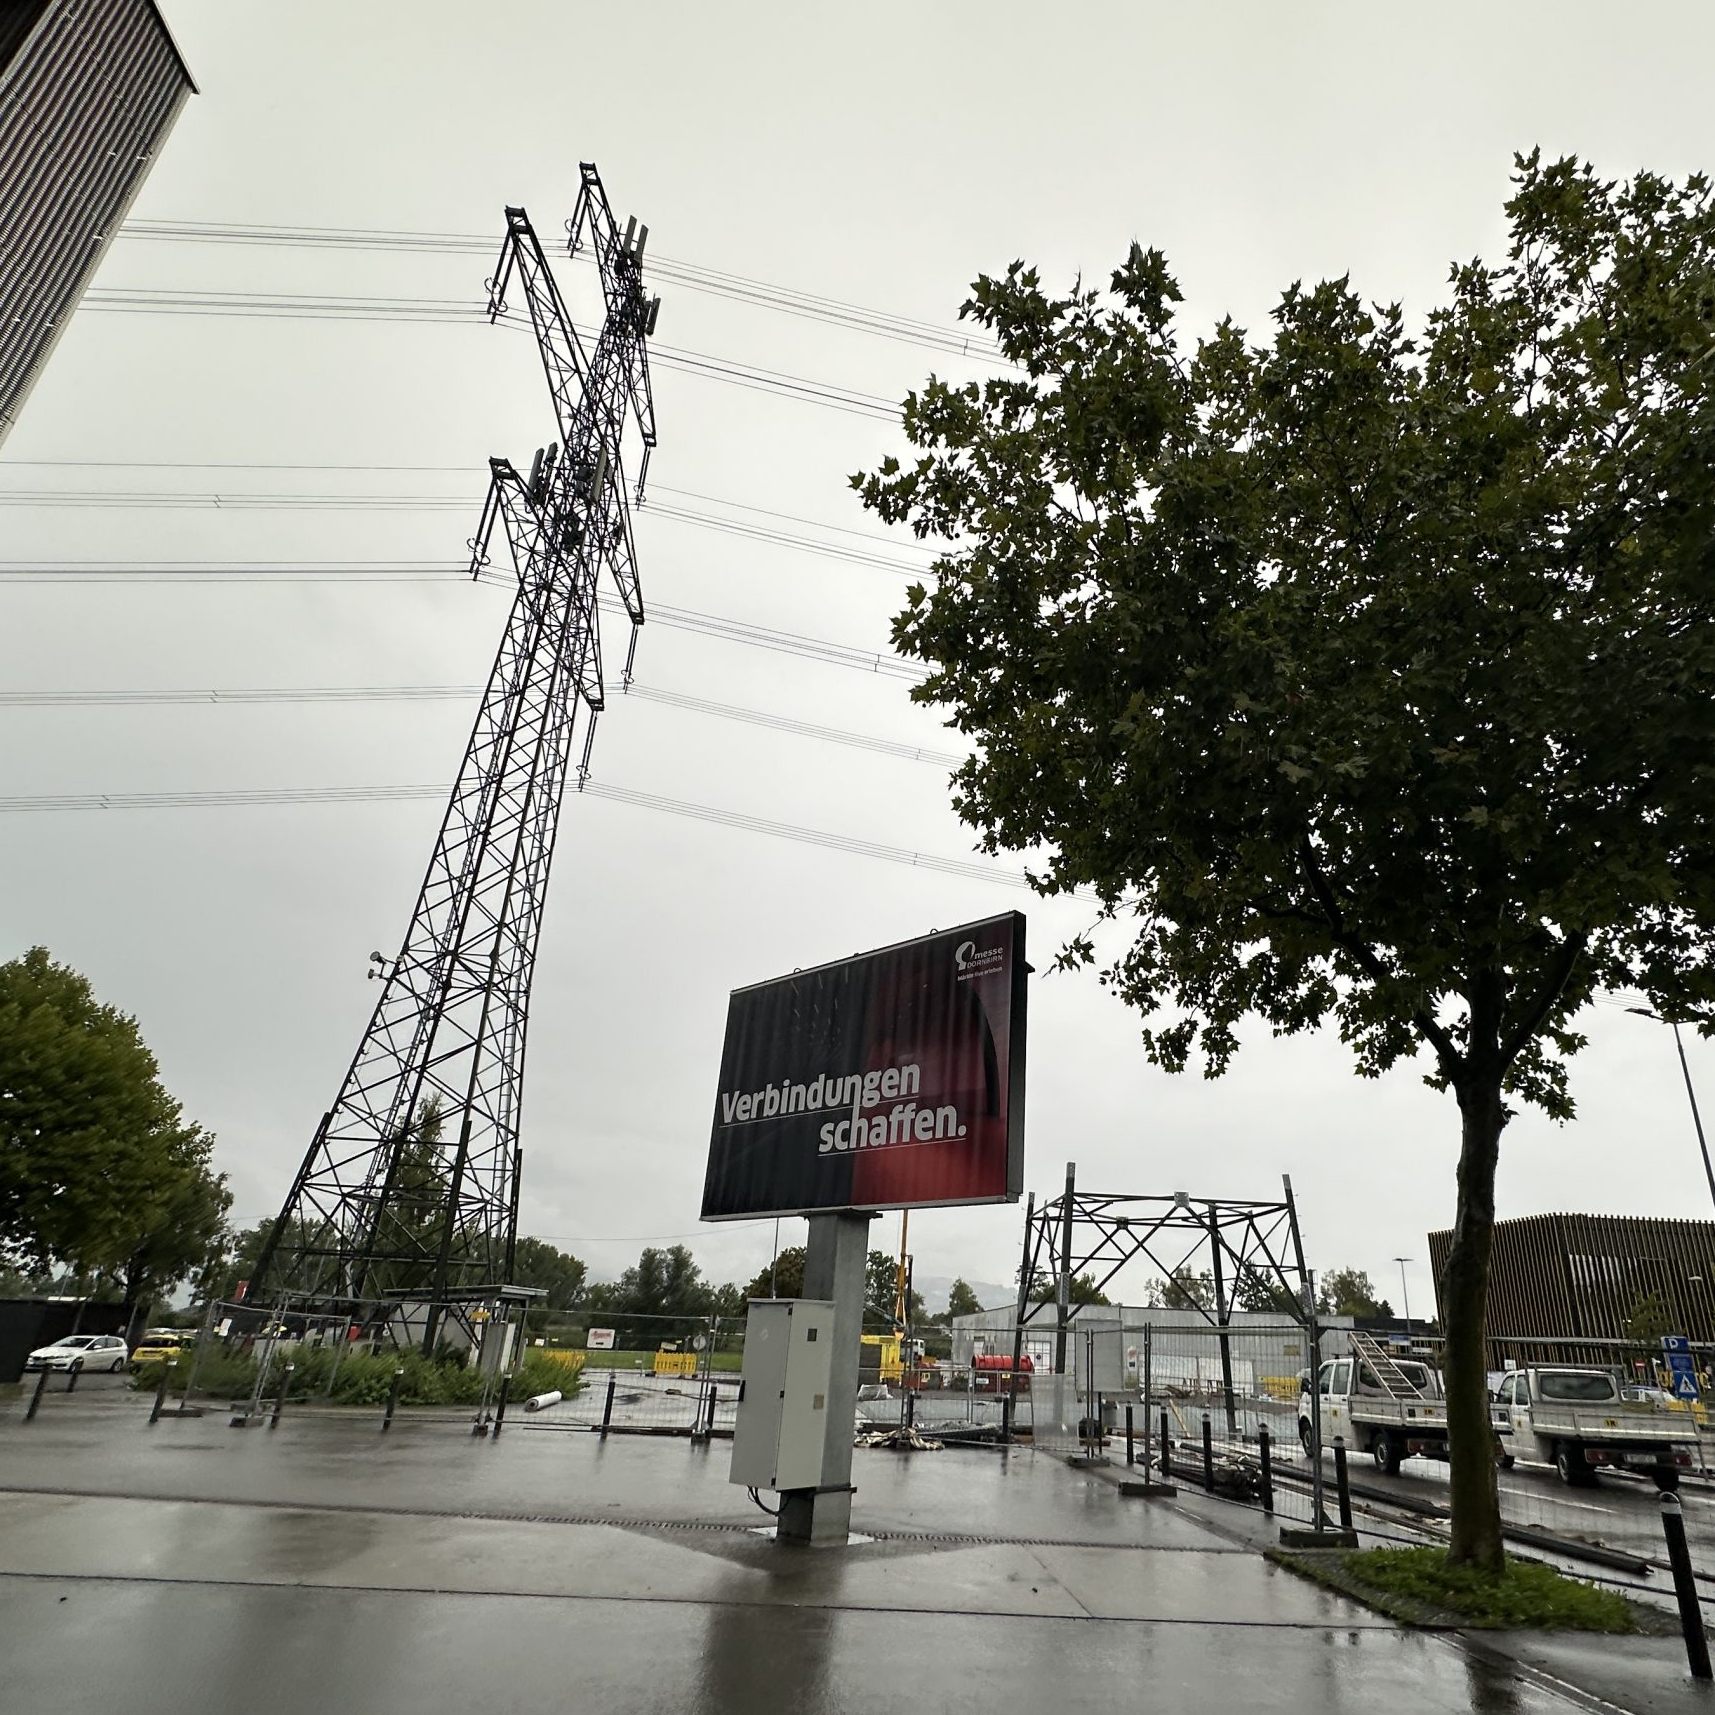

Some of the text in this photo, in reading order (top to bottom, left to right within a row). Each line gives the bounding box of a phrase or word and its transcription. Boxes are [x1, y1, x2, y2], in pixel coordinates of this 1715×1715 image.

[966, 954, 1004, 969] DORNBIRN
[974, 946, 1004, 960] messe
[722, 1063, 920, 1123] Verbindungen
[819, 1103, 967, 1152] schaffen.
